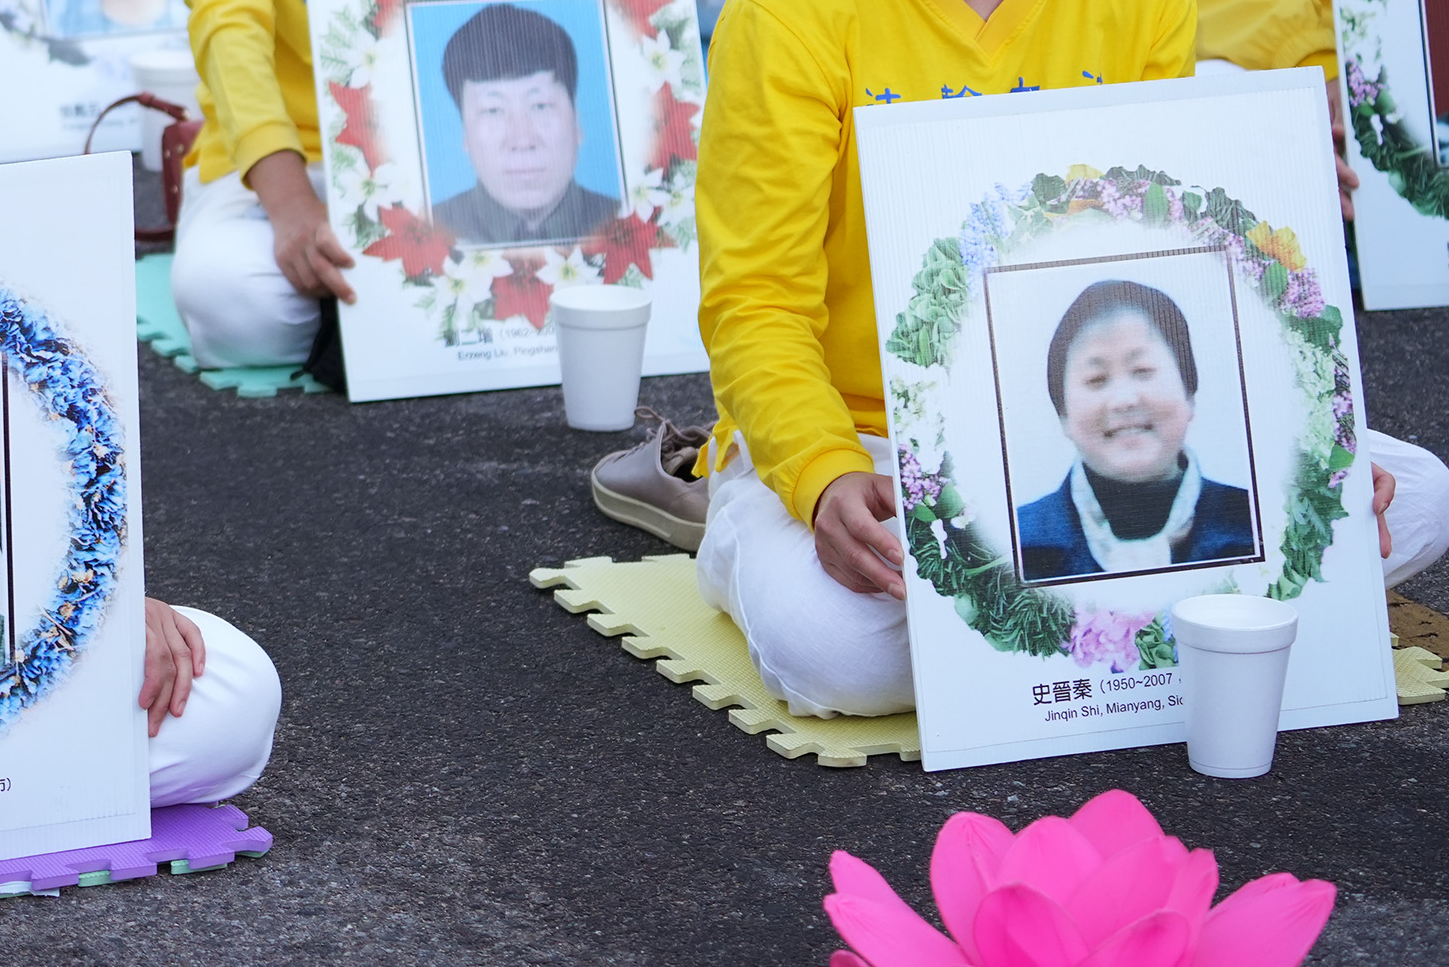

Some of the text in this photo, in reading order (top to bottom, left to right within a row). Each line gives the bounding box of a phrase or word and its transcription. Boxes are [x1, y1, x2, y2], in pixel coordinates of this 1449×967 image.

[1045, 707, 1078, 722] Jinqin
[1081, 703, 1103, 718] Shi,
[1106, 697, 1165, 714] Mianyang,
